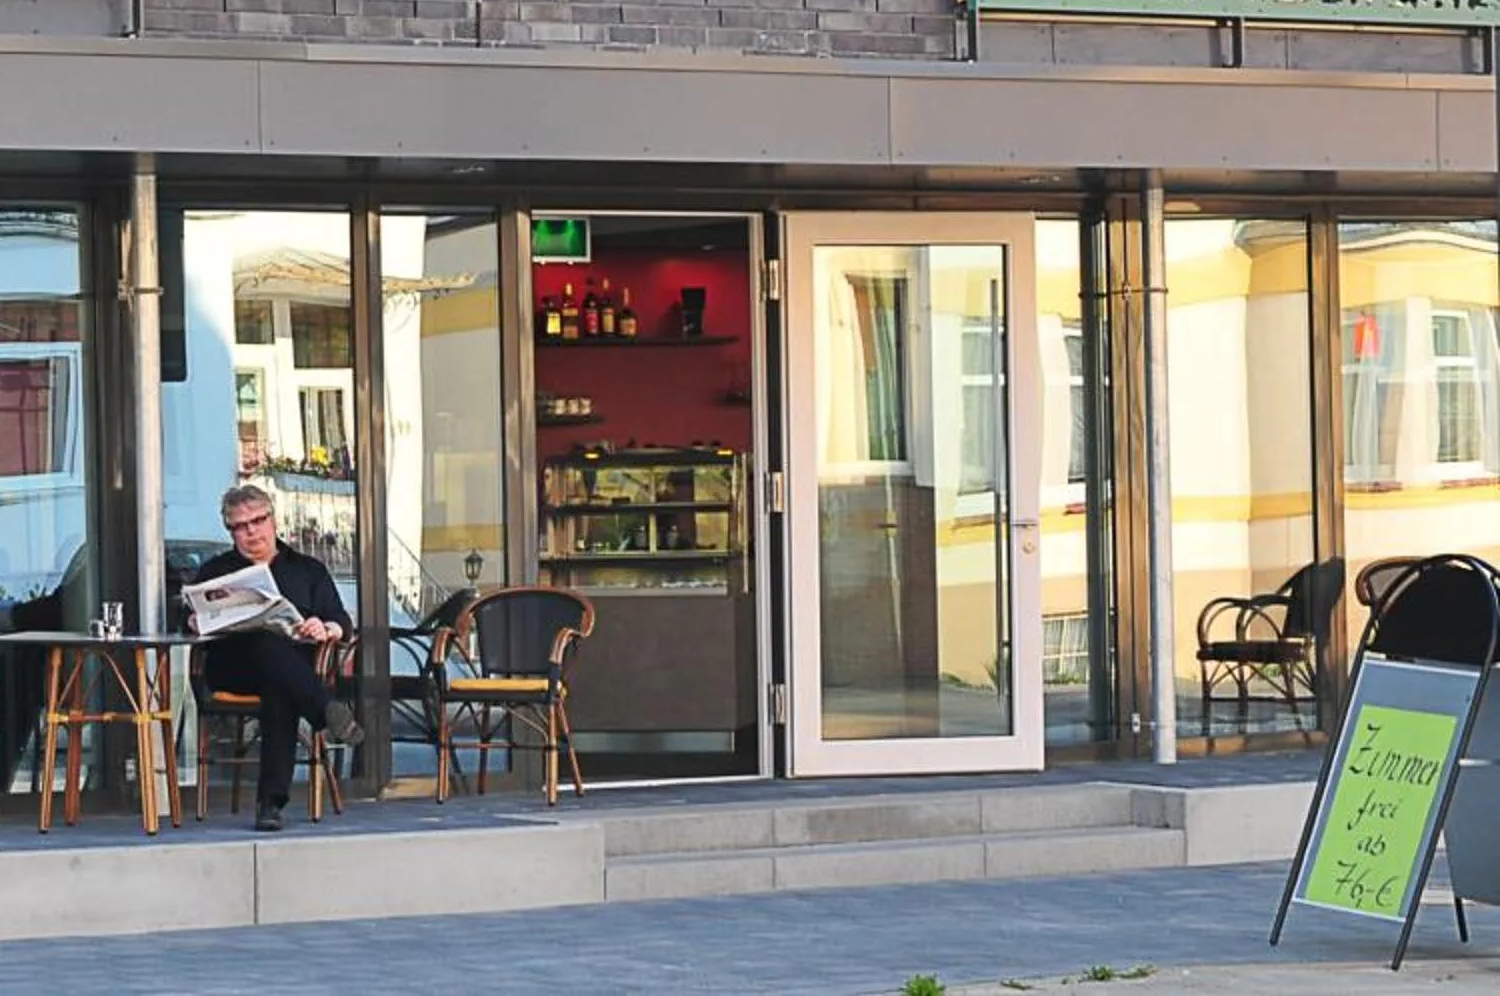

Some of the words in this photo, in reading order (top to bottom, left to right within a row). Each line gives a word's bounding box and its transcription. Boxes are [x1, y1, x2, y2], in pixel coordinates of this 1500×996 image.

[1348, 723, 1440, 786] Zimmer
[1347, 789, 1403, 831] frei
[1357, 835, 1386, 857] ab
